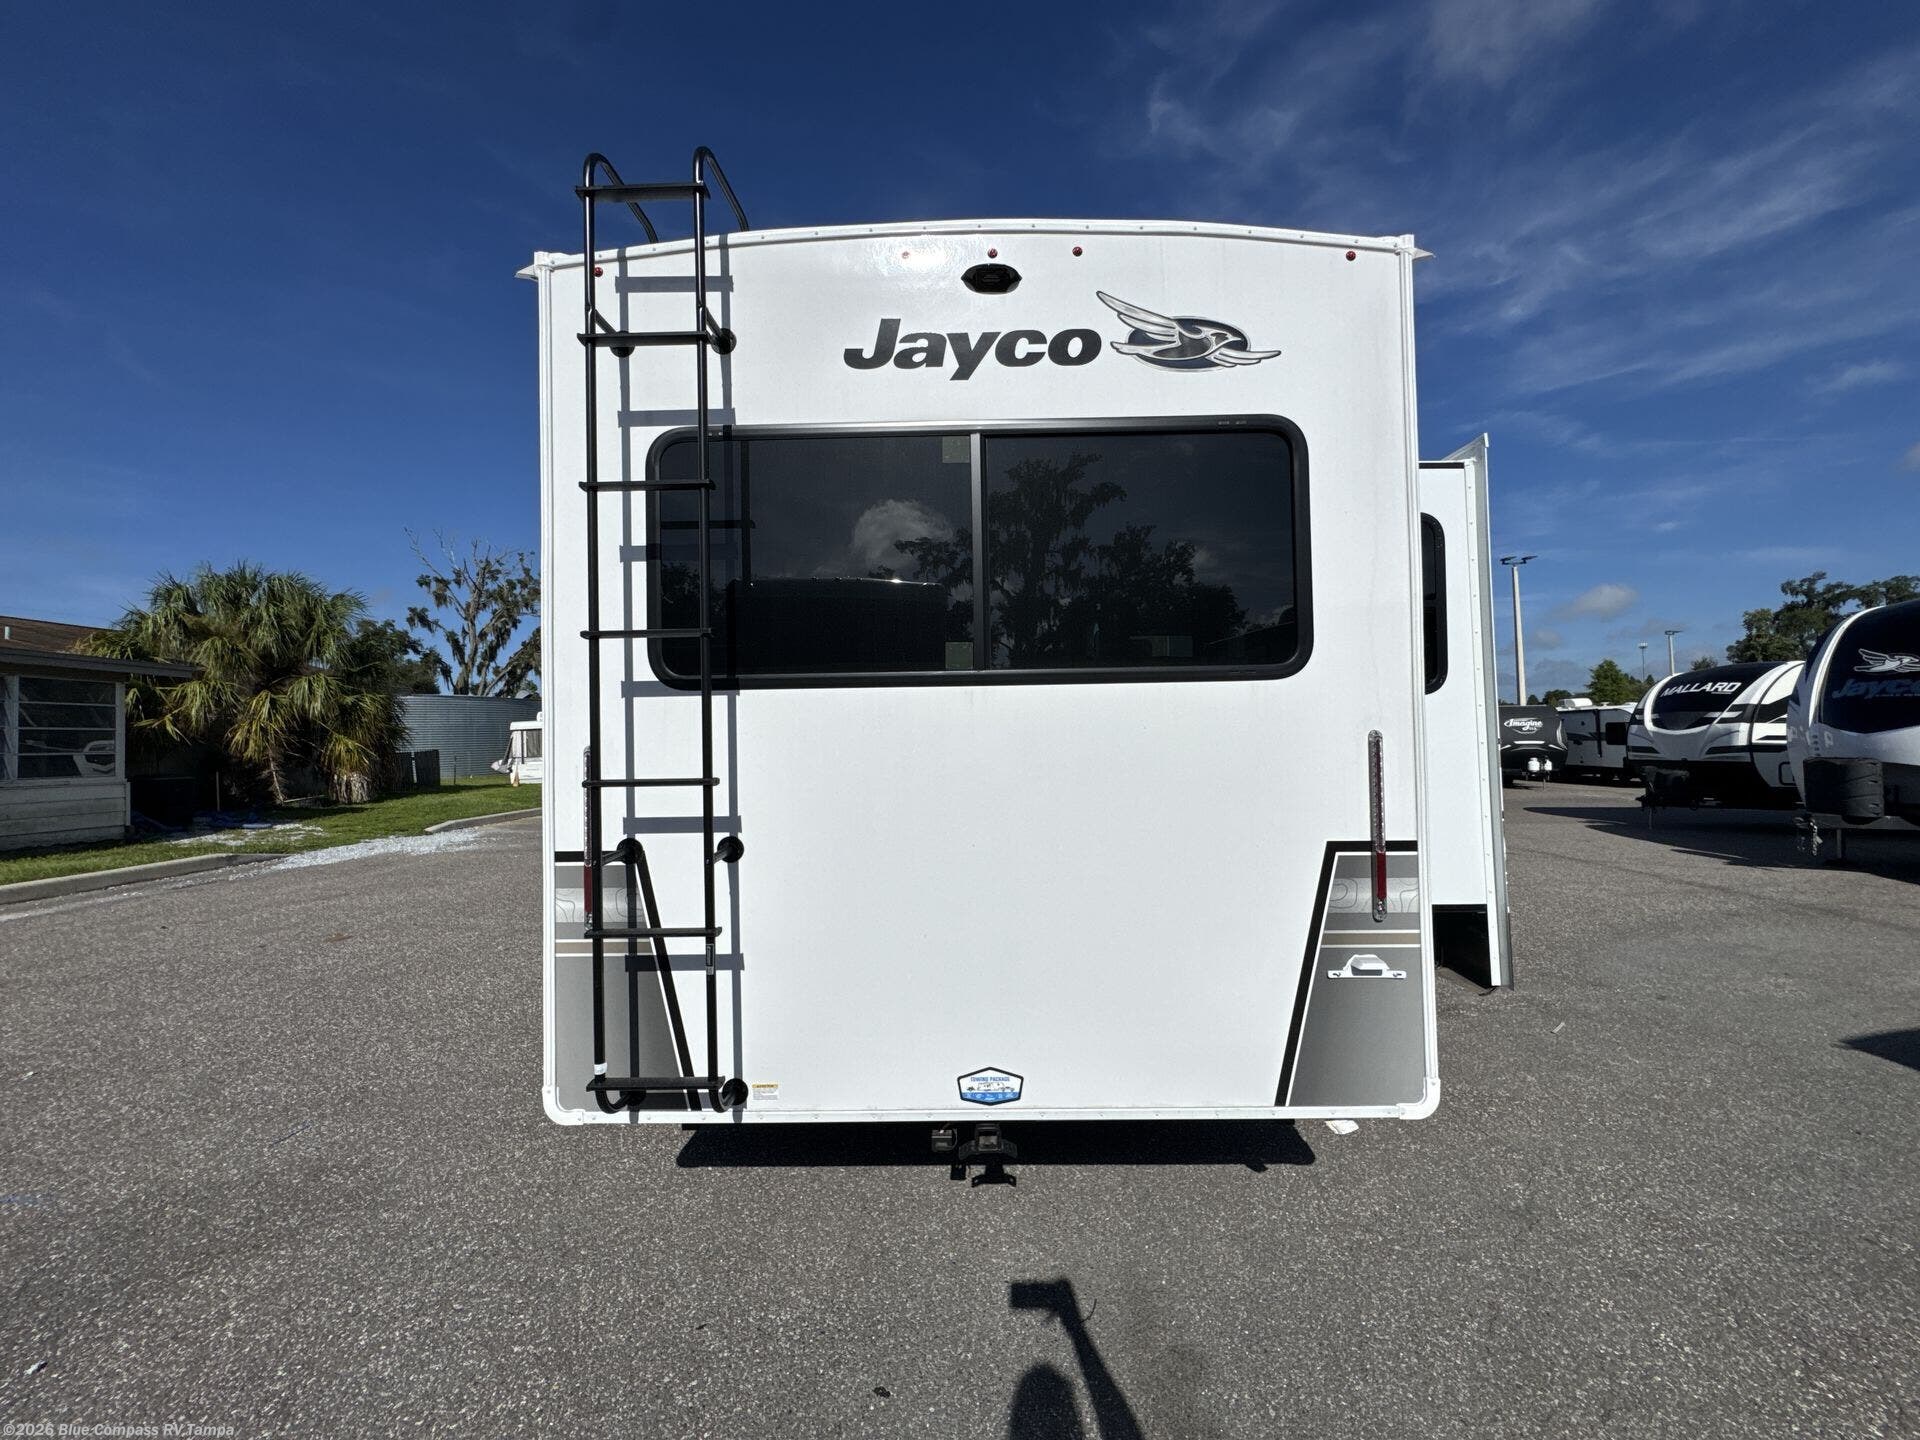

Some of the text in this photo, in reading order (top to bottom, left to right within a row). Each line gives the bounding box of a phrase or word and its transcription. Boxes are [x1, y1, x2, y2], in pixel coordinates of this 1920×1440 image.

[843, 318, 1101, 380] Jayco
[1660, 682, 1742, 697] MALLARD
[1504, 719, 1543, 731] Imagine
